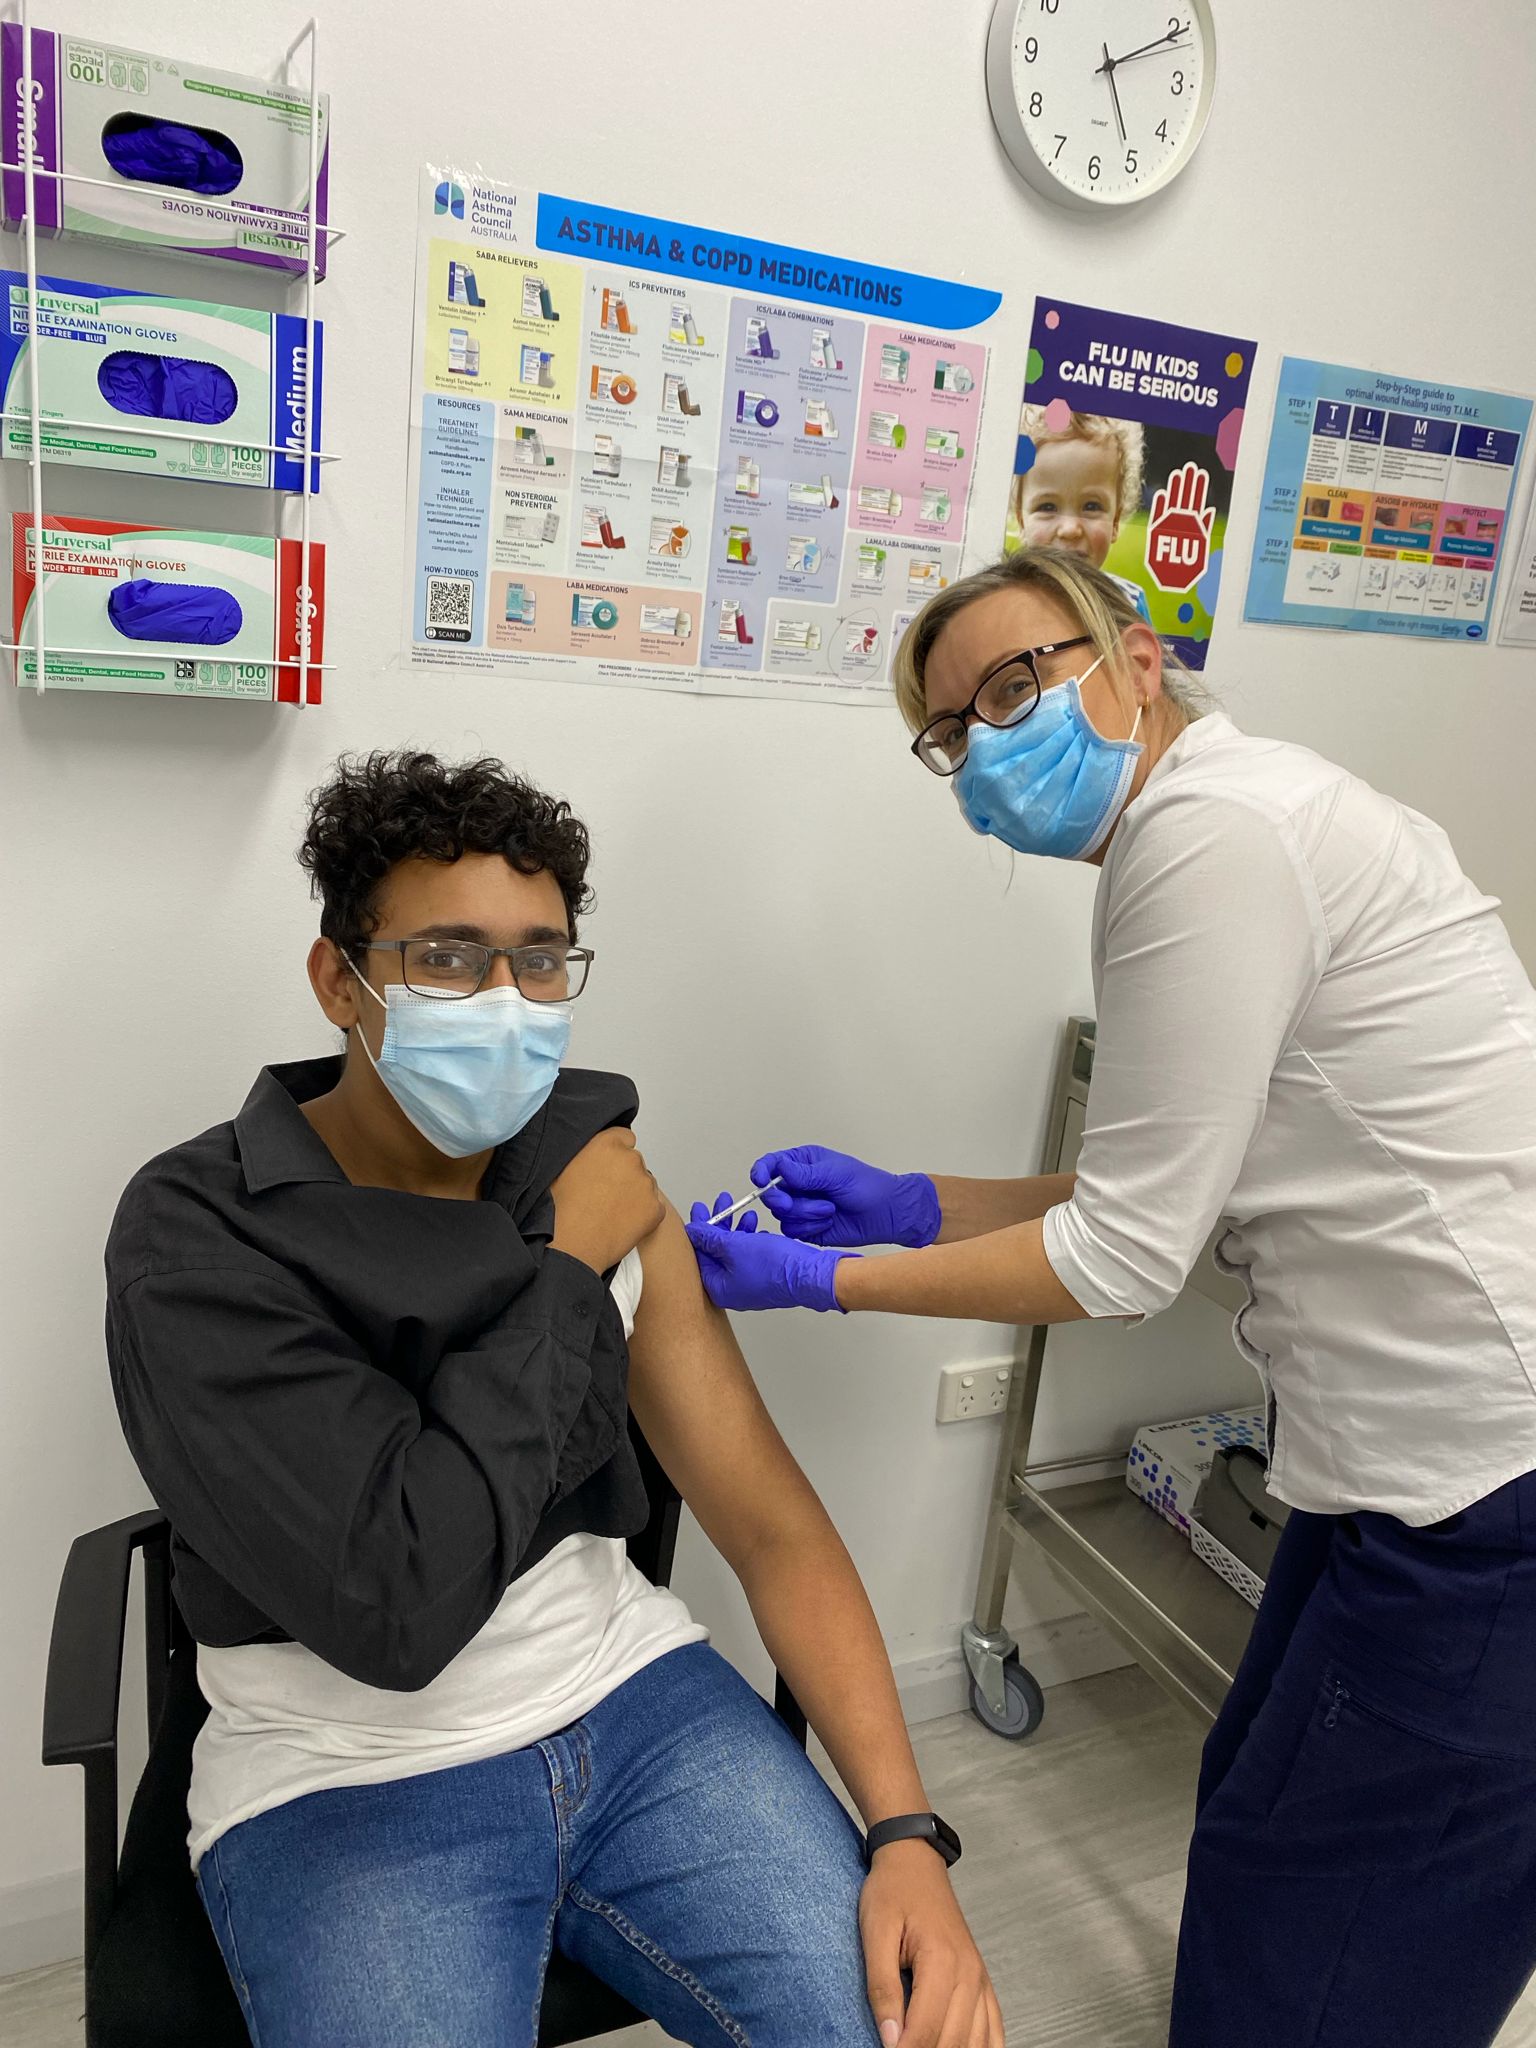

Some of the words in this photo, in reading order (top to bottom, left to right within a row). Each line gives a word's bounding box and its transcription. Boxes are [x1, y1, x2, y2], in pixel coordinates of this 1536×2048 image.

[1167, 17, 1180, 43] 2
[1024, 37, 1038, 63] 9
[69, 52, 104, 67] PIECES
[70, 61, 104, 83] 100
[1171, 71, 1184, 95] 3
[1029, 92, 1043, 117] 8
[1155, 119, 1167, 142] 4
[1054, 134, 1067, 158] 7
[1088, 156, 1101, 179] 6
[1125, 149, 1138, 173] 5
[473, 187, 517, 206] National
[162, 200, 203, 216] GLOVES
[472, 200, 512, 217] Asthma
[207, 208, 278, 231] EXAMINATION
[471, 212, 511, 230] Council
[471, 226, 517, 242] AUSTRALIA
[476, 250, 497, 262] SABA
[498, 255, 538, 270] RELIEVERS
[558, 216, 661, 258] ASTHMA
[668, 240, 685, 263] &
[692, 244, 752, 276] COPD
[759, 257, 903, 307] MEDICATIONS
[629, 280, 640, 289] ICS
[642, 282, 686, 298] PREVENTERS
[756, 305, 786, 316] ICS/LABA
[788, 311, 834, 326] COMBINATIONS
[13, 310, 50, 323] NITILE
[55, 315, 132, 336] EXAMINATION
[135, 328, 177, 342] GLOVES
[86, 335, 104, 343] BLUE
[899, 333, 916, 343] LAMA
[918, 337, 956, 350] MEDICATIONS
[1088, 341, 1127, 366] FLU
[1131, 349, 1152, 371] IN
[1155, 354, 1199, 381] KIDS
[1059, 360, 1105, 387] CAN
[1108, 369, 1136, 392] BE
[1138, 375, 1219, 408] SERIOUS
[1375, 379, 1421, 396] Step-by-Step
[1422, 387, 1445, 400] guide
[1446, 391, 1455, 401] to
[285, 346, 308, 463] Medium
[438, 398, 481, 412] RESOURCES
[1288, 398, 1306, 408] STEP
[1308, 399, 1312, 409] 1
[1345, 387, 1374, 402] optimal
[1375, 393, 1399, 405] wound
[1401, 397, 1428, 412] healing
[1430, 403, 1451, 416] using
[504, 408, 525, 419] SAMA
[526, 411, 568, 425] MEDICATION
[1329, 405, 1339, 421] T
[1366, 411, 1372, 426] I
[438, 426, 479, 437] GUIDELINES
[439, 418, 479, 429] TREATMENT
[1414, 419, 1428, 435] M
[1486, 432, 1495, 446] E
[50, 439, 75, 448] Medical,
[127, 447, 154, 458] Handling
[232, 447, 262, 463] 100
[231, 461, 262, 472] PIECES
[231, 469, 241, 477] (by
[242, 470, 262, 479] weight)
[436, 494, 474, 505] TECHNIQUE
[441, 487, 470, 497] INHALER
[505, 490, 520, 499] NON
[521, 492, 558, 503] STEROIDAL
[1274, 487, 1291, 496] STEP
[1328, 489, 1348, 499] CLEAN
[510, 499, 552, 510] PREVENTER
[1376, 497, 1401, 506] ABSORB
[1409, 501, 1440, 511] HYDRATE
[1463, 508, 1488, 518] PROTECT
[42, 531, 113, 551] Universal
[866, 537, 899, 548] LAMA/LABA
[901, 541, 941, 553] COMBINATIONS
[1266, 538, 1283, 547] STEP
[1284, 540, 1289, 548] 3
[1155, 534, 1199, 567] FLU
[29, 550, 65, 561] NTRILE
[68, 552, 143, 569] EXAMINATION
[146, 561, 186, 572] GLOVES
[31, 563, 85, 574] PWDER-FREE
[98, 569, 116, 577] BLUE
[424, 565, 453, 575] HOW-TO
[454, 567, 479, 577] VIDEOS
[567, 581, 584, 590] LABA
[586, 583, 629, 594] MEDICATIONS
[438, 630, 455, 638] SCAN
[456, 632, 466, 640] ME
[61, 668, 87, 676] Medical,
[88, 669, 108, 677] Dental,
[137, 672, 163, 680] Handling
[237, 665, 267, 680] 100
[236, 679, 267, 688] PIECES
[236, 686, 245, 694] (by
[246, 687, 267, 695] weight)
[1149, 1420, 1201, 1433] LINCON
[1138, 1439, 1163, 1462] LINCON
